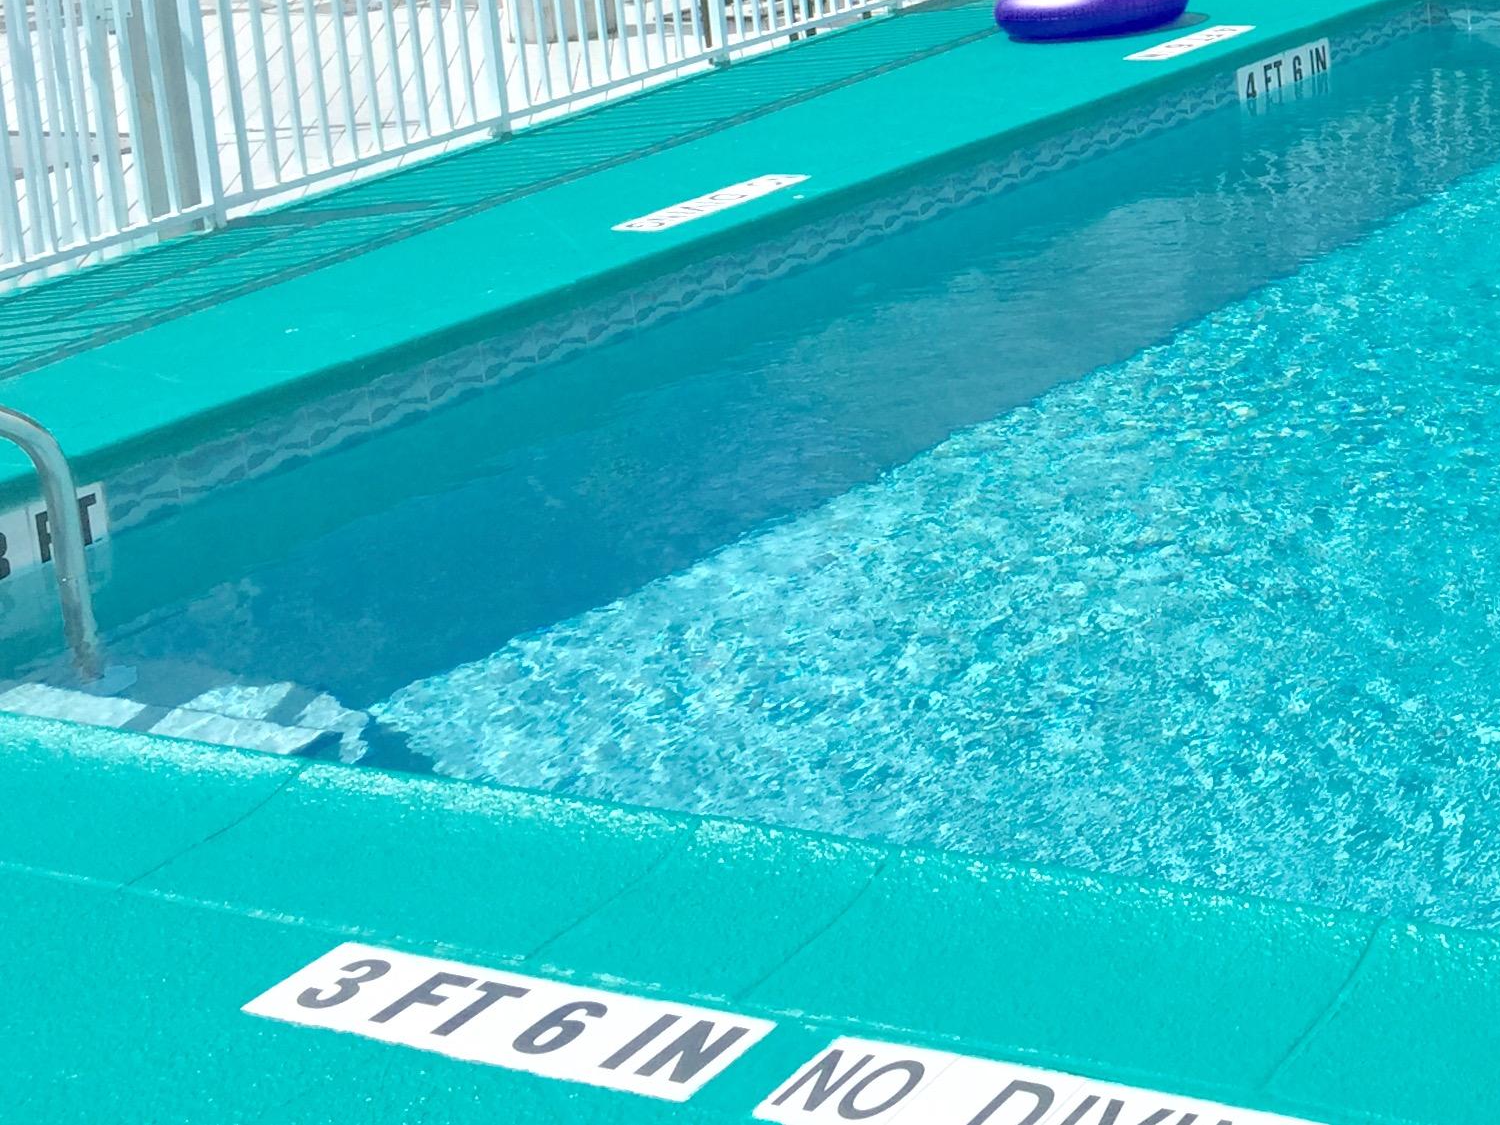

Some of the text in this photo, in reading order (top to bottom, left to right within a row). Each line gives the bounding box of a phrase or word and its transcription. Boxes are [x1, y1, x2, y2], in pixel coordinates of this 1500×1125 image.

[1246, 71, 1257, 99] 4
[1263, 59, 1283, 93] FT
[1309, 44, 1327, 76] IN
[297, 959, 751, 1084] 3 FT 6 IN
[771, 1049, 925, 1120] NO
